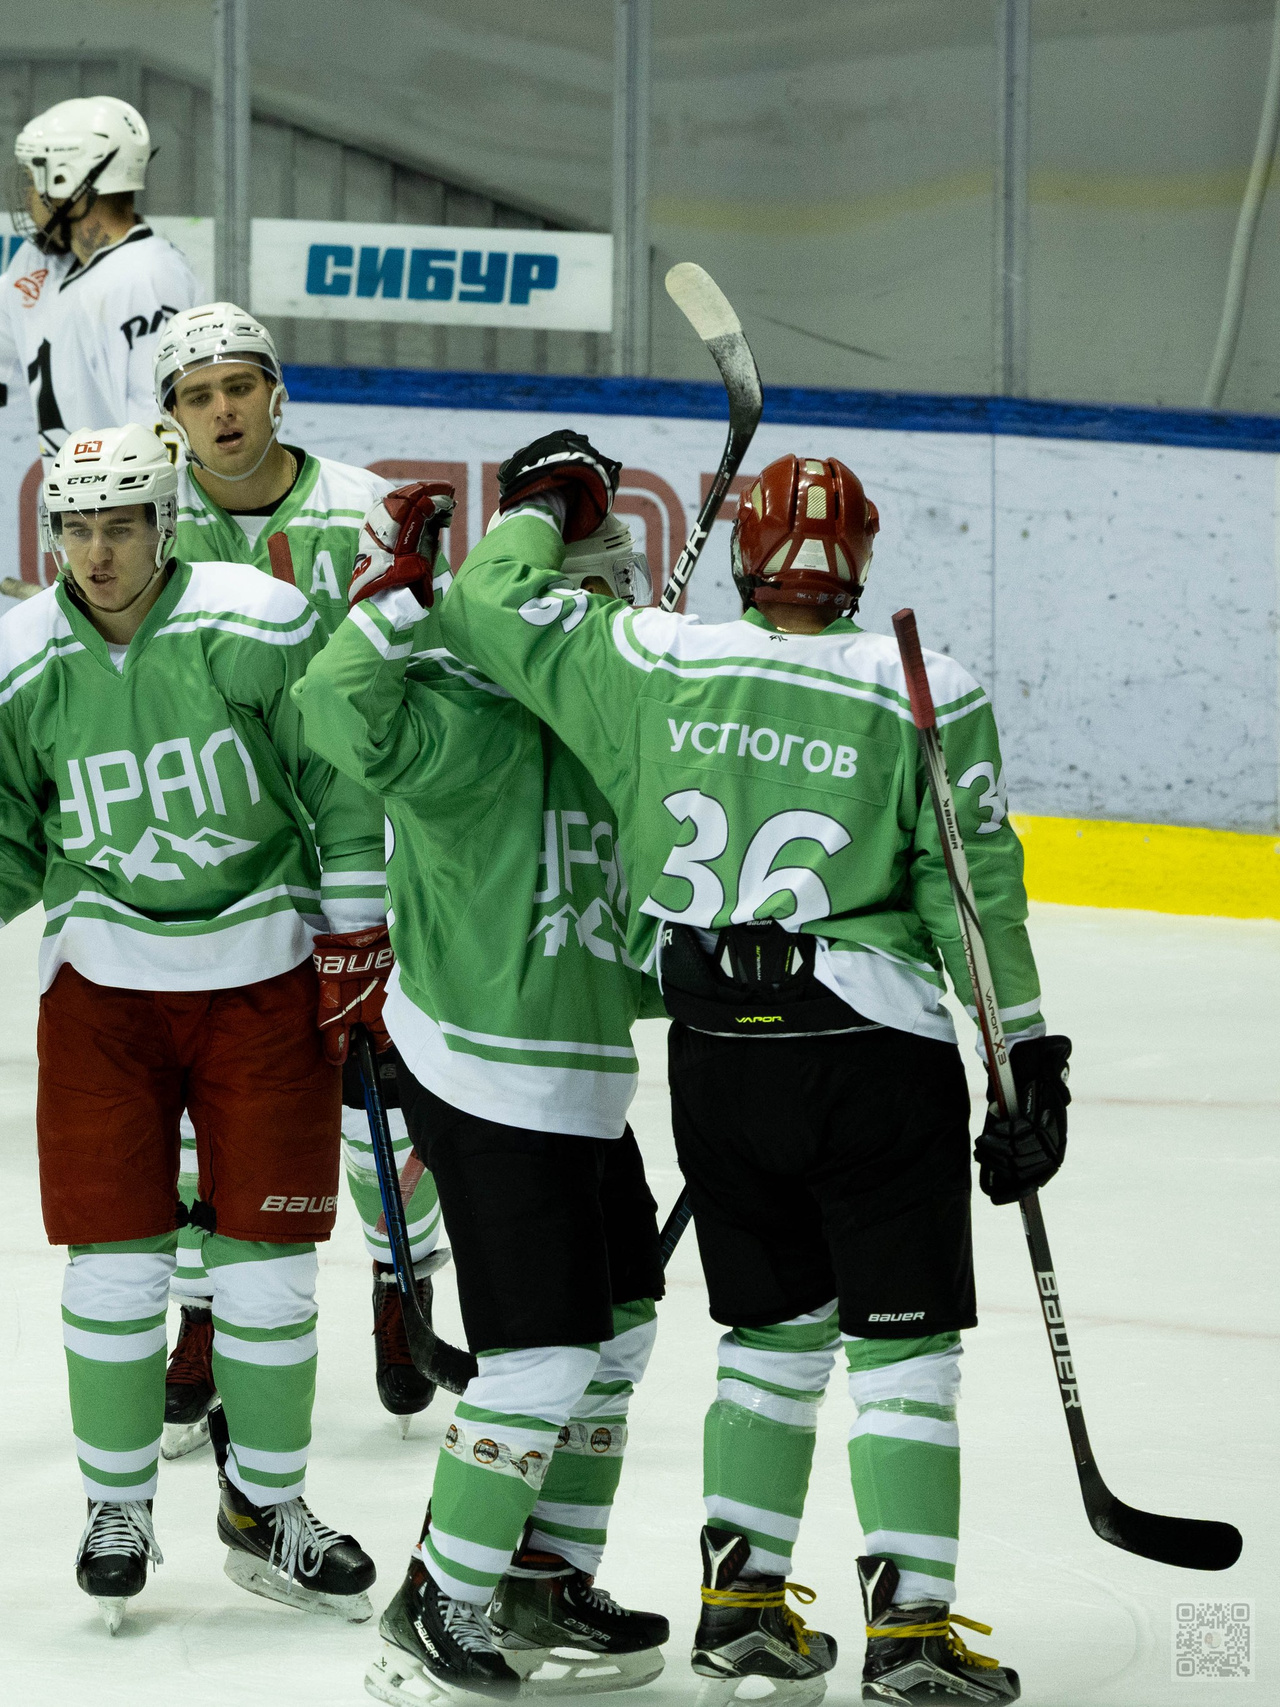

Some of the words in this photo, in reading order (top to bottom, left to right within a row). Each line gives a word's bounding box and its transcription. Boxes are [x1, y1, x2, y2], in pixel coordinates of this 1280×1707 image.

[306, 243, 559, 306] СИБУР
[66, 474, 108, 486] CCM
[310, 550, 342, 600] A
[667, 718, 859, 779] УСТЮГОВ
[943, 808, 959, 850] BAUER
[639, 788, 853, 934] 36
[868, 1311, 925, 1322] BAUER
[1037, 1271, 1082, 1409] BAUER
